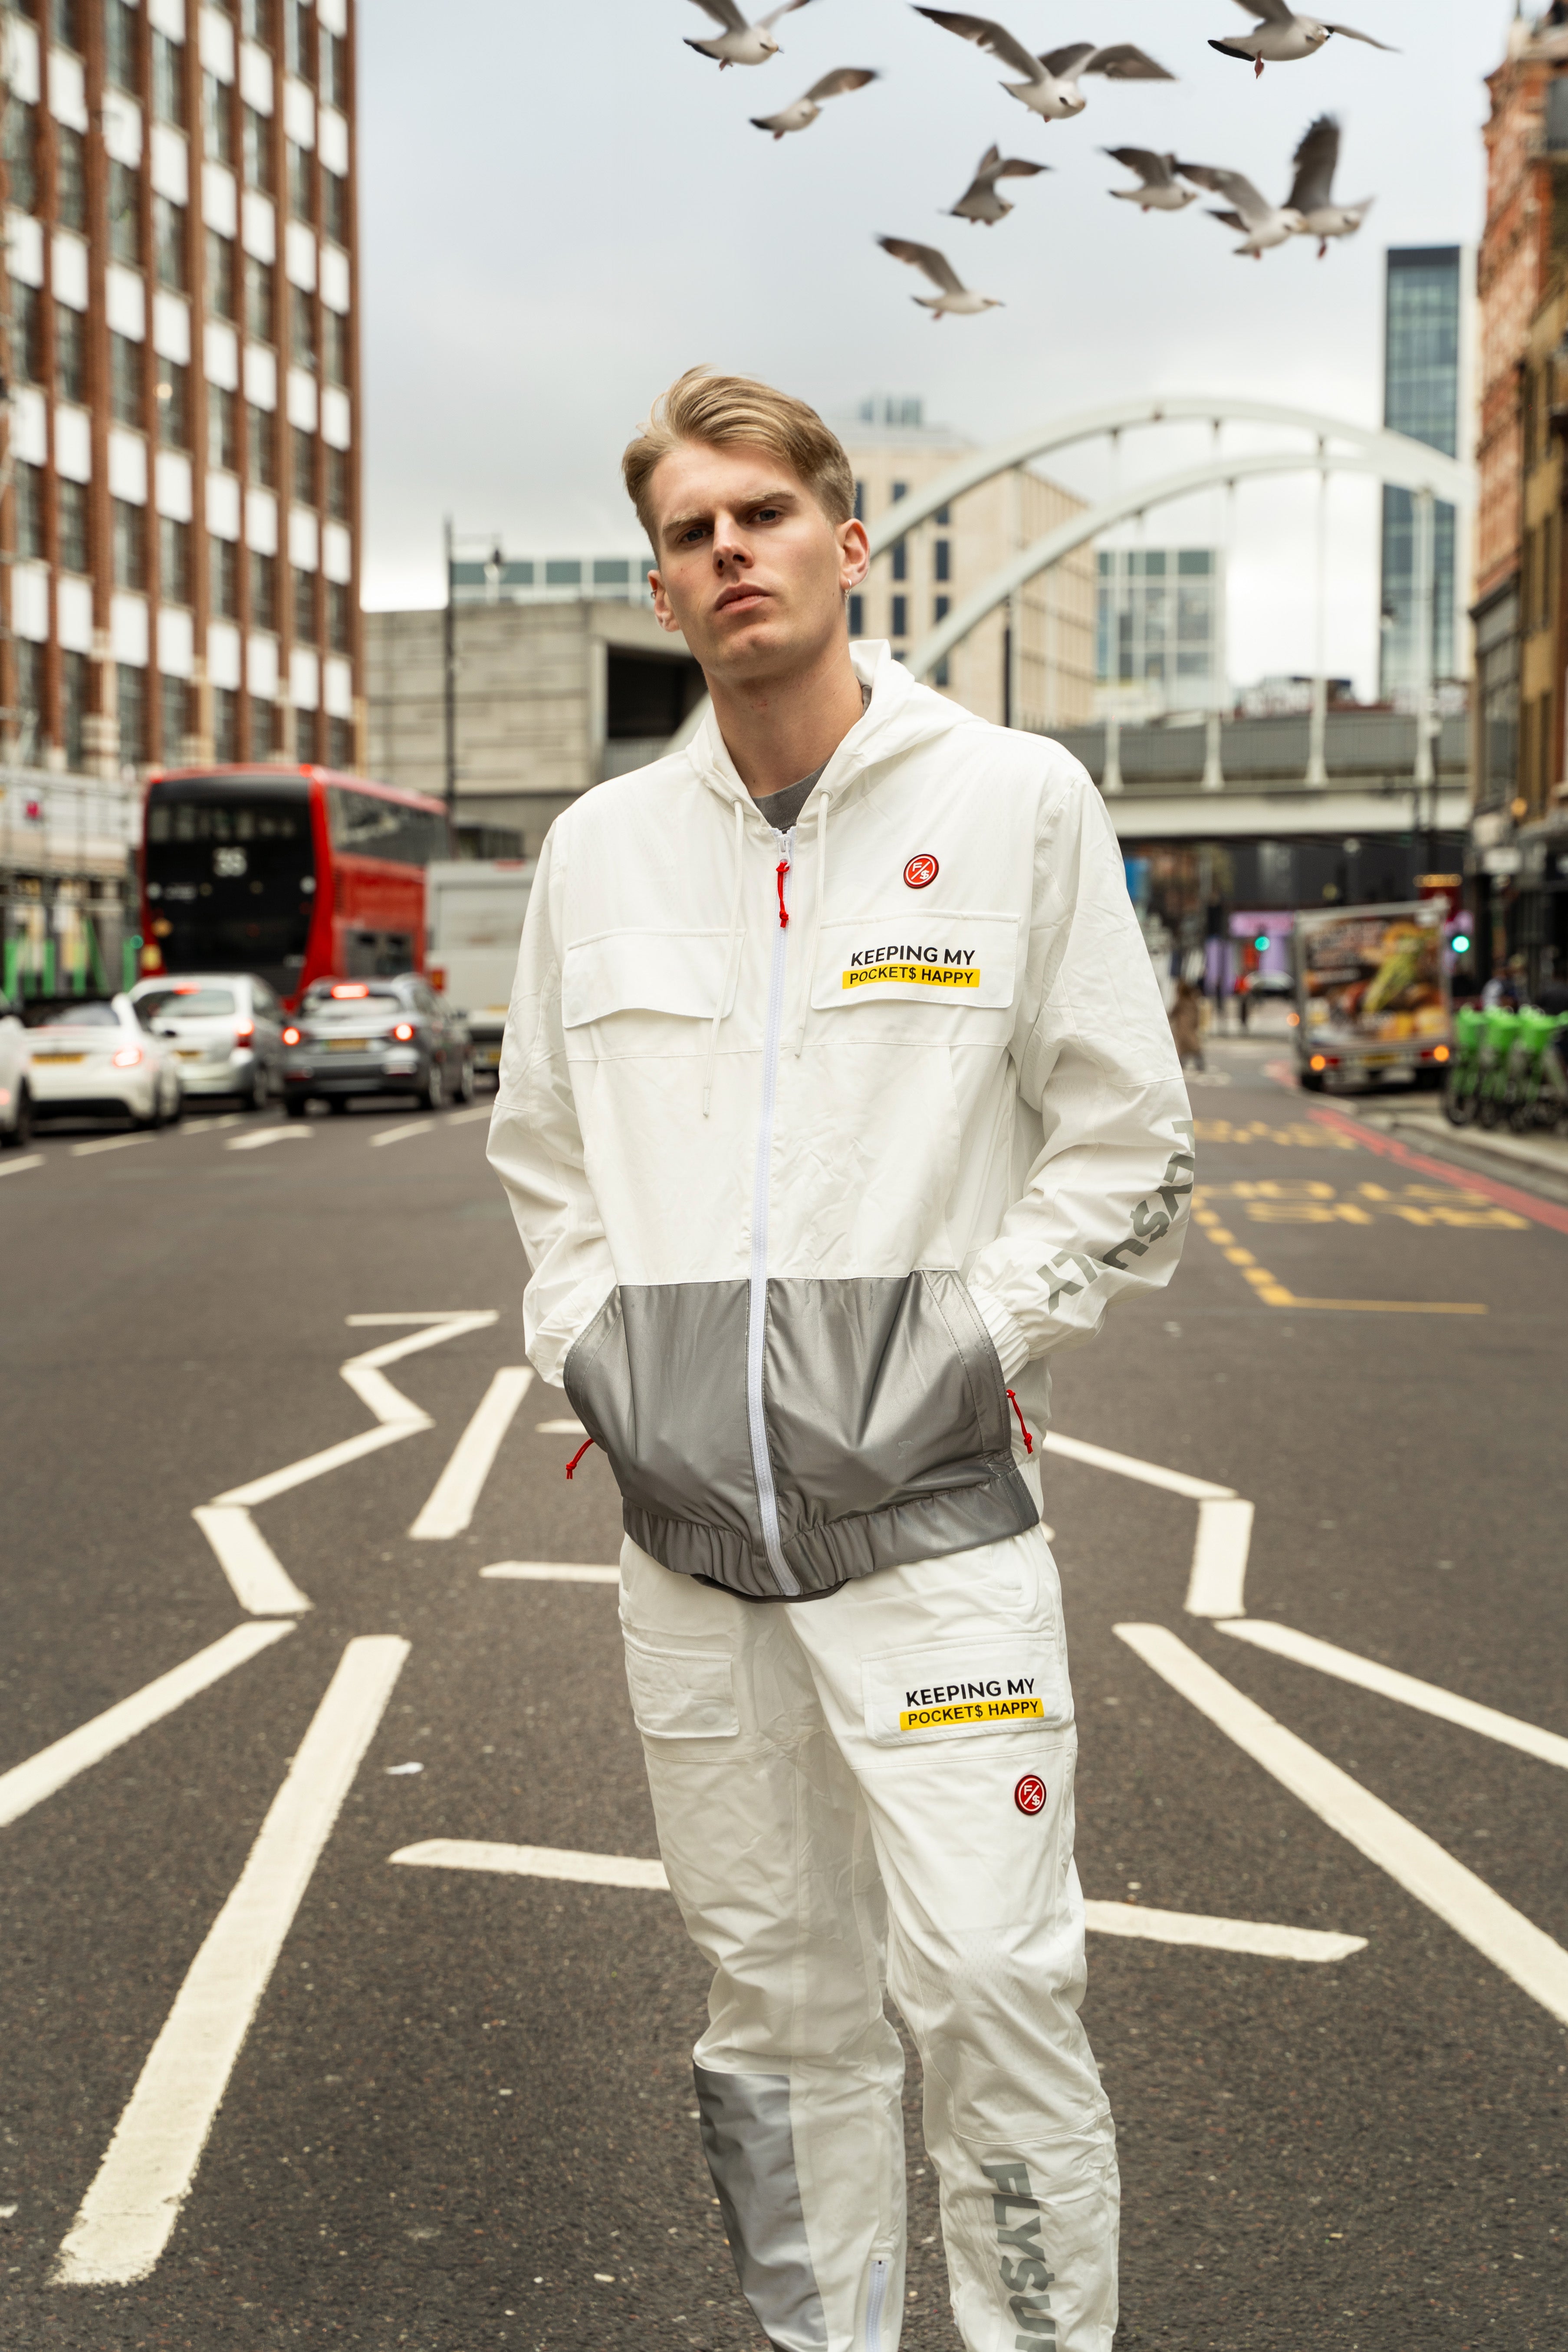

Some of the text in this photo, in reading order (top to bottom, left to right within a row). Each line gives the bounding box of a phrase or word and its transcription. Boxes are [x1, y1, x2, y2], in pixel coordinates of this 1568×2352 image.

[851, 946, 975, 966] KEEPING MY
[850, 966, 973, 984] POCKET$ HAPPY
[906, 1678, 1034, 1707] KEEPING MY
[908, 1701, 1038, 1725] POCKET$ HAPPY
